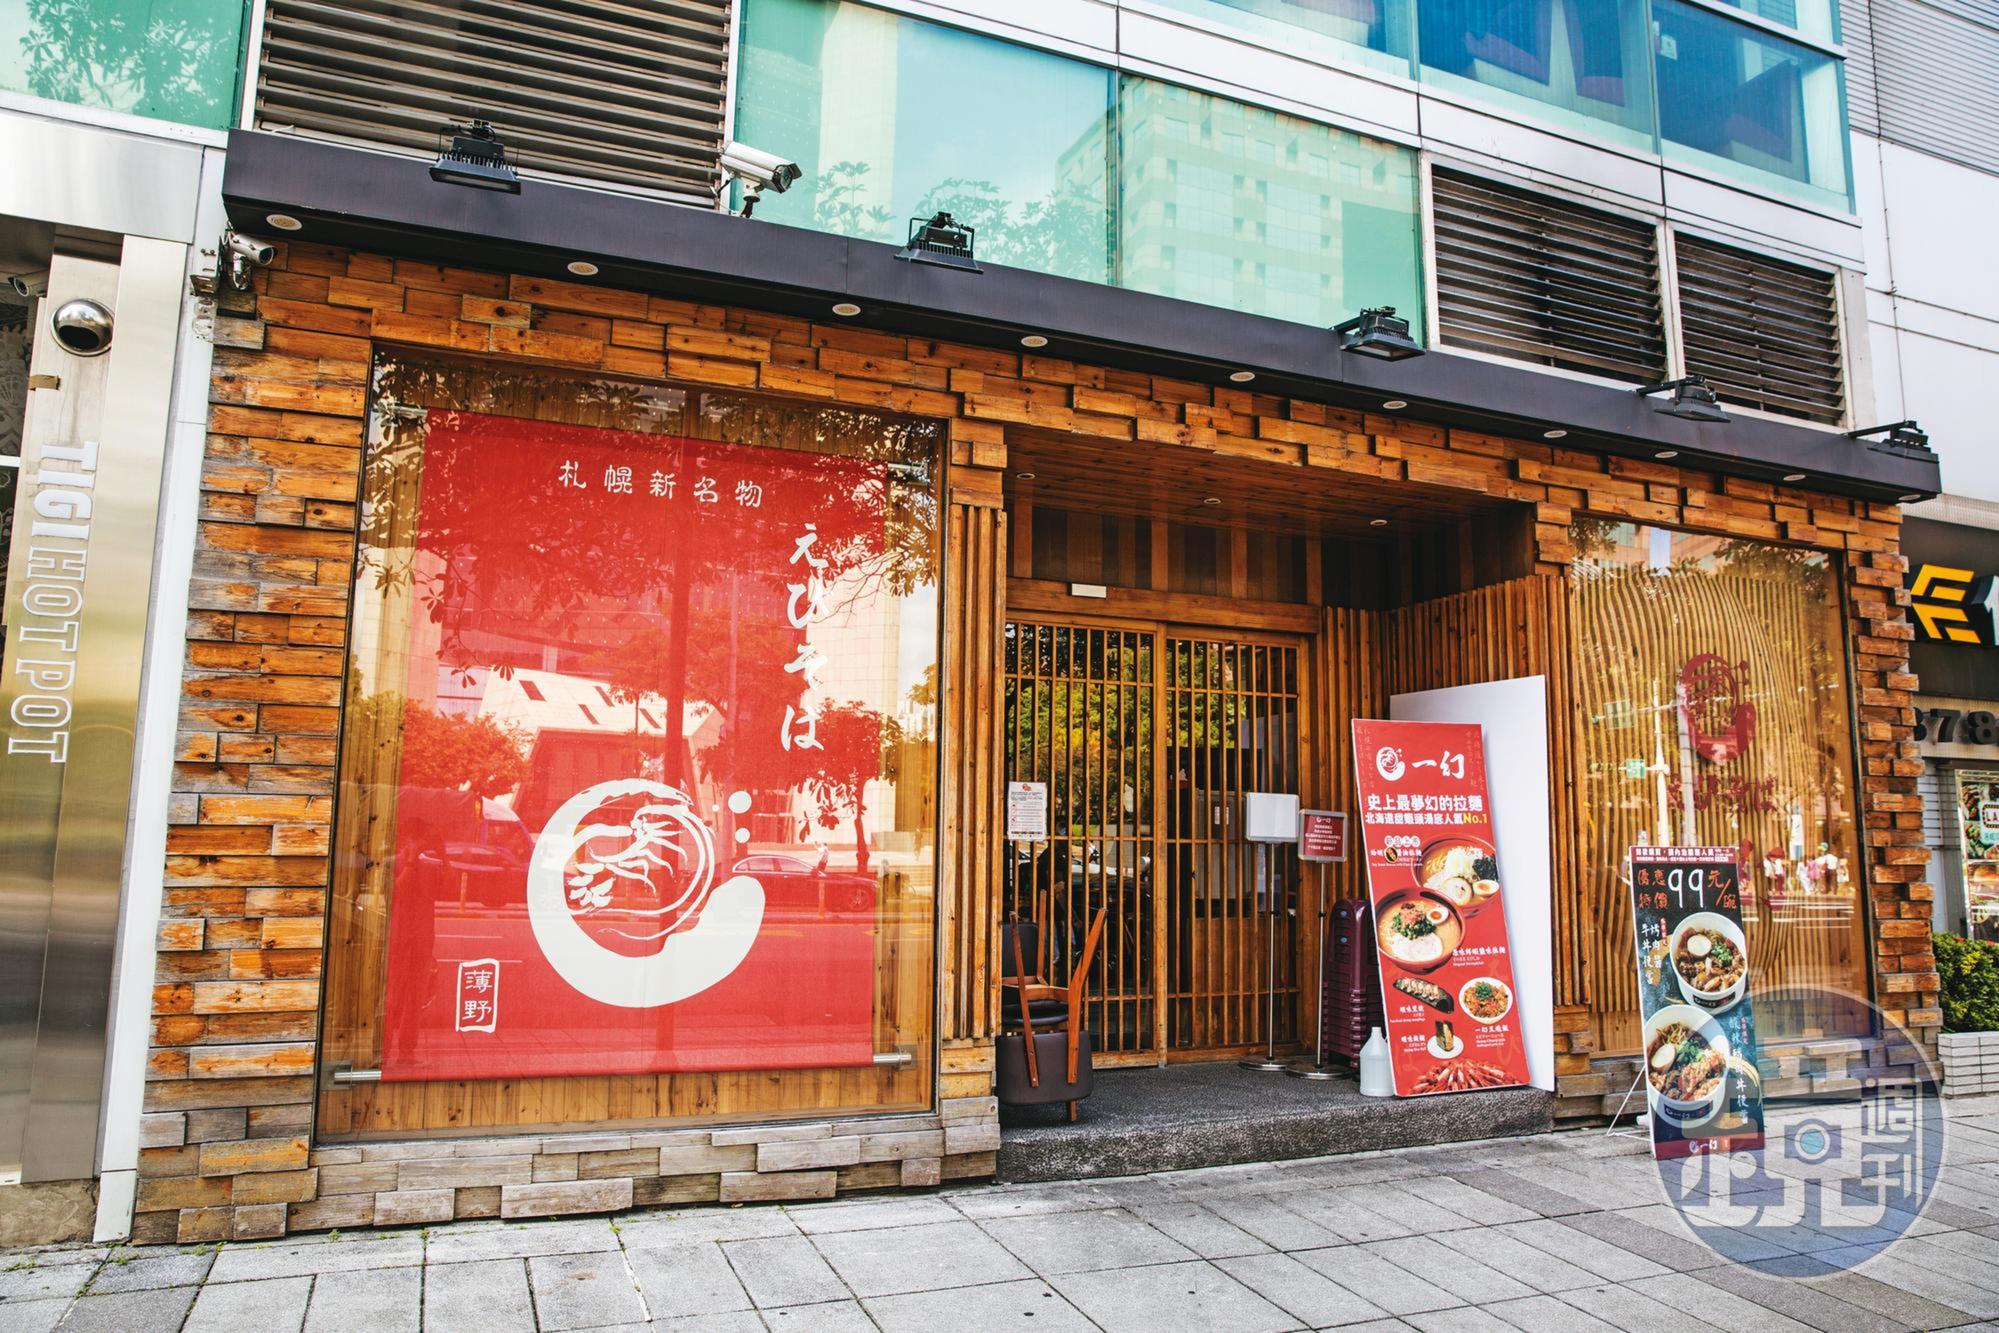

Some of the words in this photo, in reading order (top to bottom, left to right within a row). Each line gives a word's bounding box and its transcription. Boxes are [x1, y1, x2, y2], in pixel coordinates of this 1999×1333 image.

[32, 441, 100, 540] TIGI
[558, 459, 764, 509] 札幌新名物
[19, 546, 87, 651] HOT
[8, 659, 76, 763] POT
[1411, 750, 1465, 779] 一幻
[1367, 794, 1483, 812] 史上最夢幻的拉麵
[1668, 868, 1703, 908] 99
[461, 968, 494, 1023] 薄野
